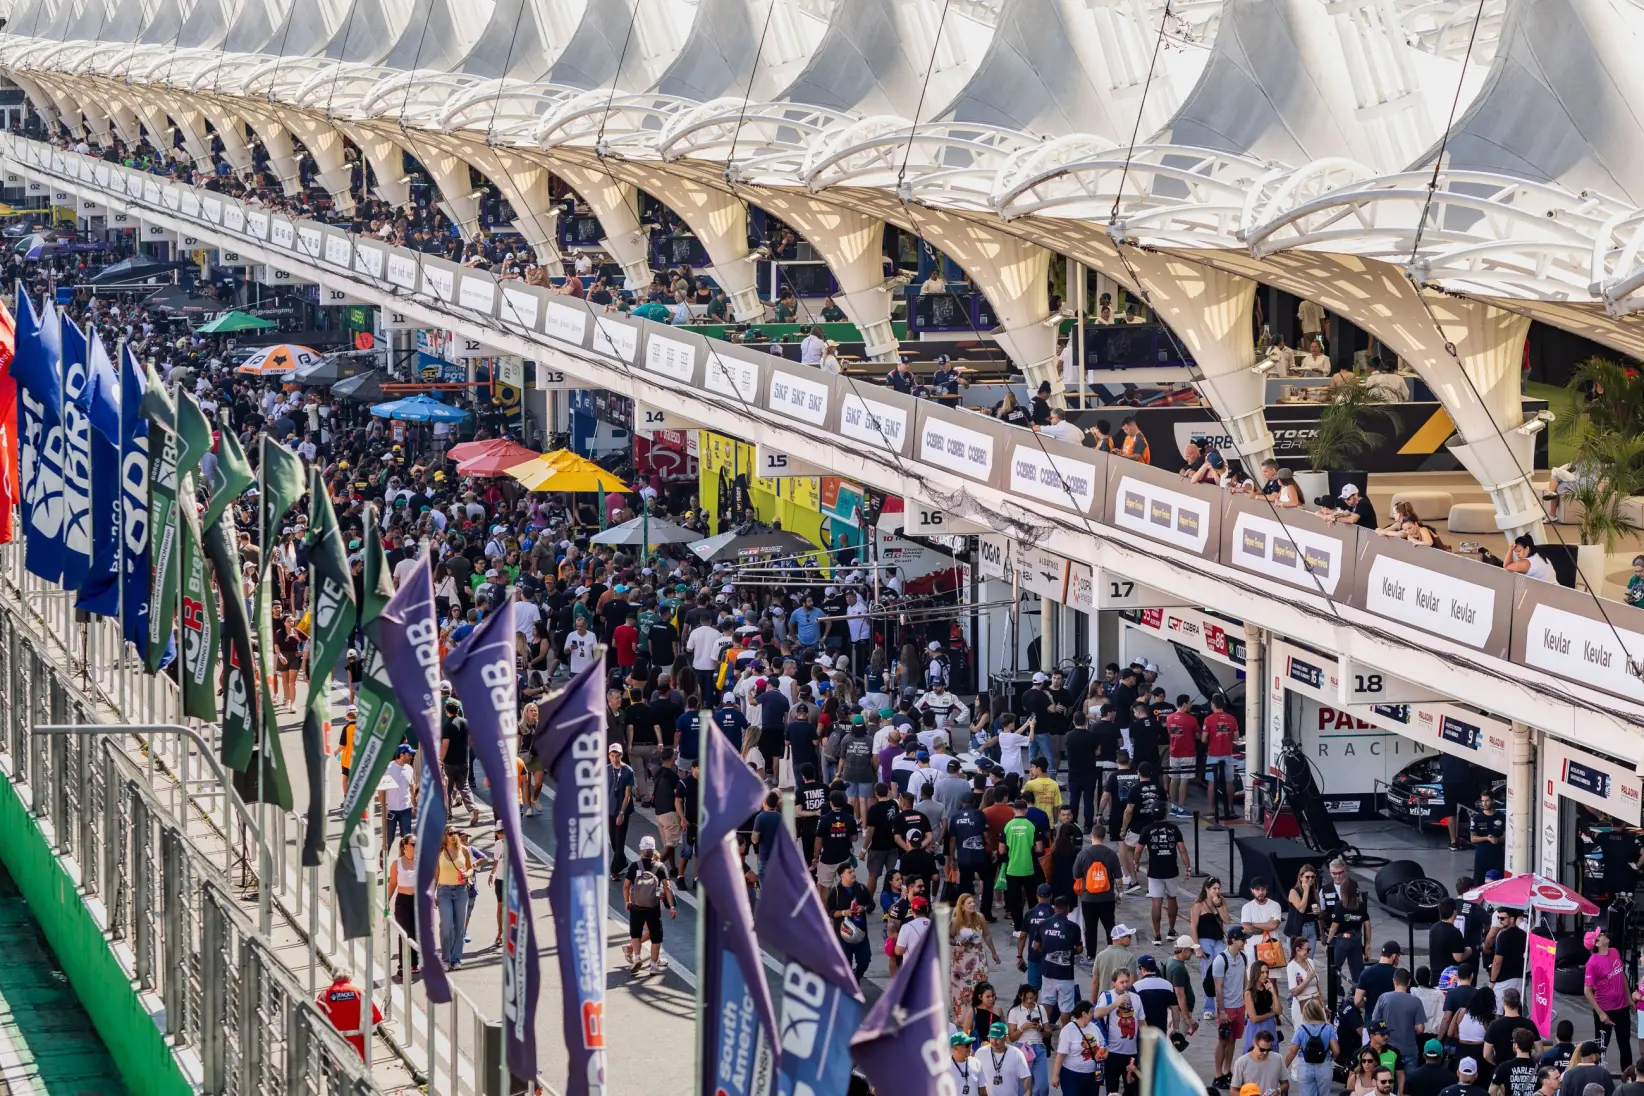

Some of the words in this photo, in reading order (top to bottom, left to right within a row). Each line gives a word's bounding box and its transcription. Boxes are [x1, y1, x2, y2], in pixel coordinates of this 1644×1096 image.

[330, 291, 344, 299] 10
[393, 314, 405, 322] 11
[465, 341, 479, 350] 12
[547, 372, 563, 382] 13
[774, 383, 788, 400] SKF
[792, 390, 806, 407] SKF
[809, 396, 823, 412] SKF
[646, 411, 664, 422] 14
[846, 406, 862, 426] SKF
[884, 418, 901, 438] SKF
[1273, 429, 1320, 438] TOCK
[1206, 436, 1233, 449] BRB
[768, 455, 786, 467] 15
[921, 511, 942, 525] 16
[1111, 582, 1134, 598] 17
[1382, 577, 1406, 603] Kevlar
[1416, 588, 1440, 614] Kevlar
[1451, 598, 1476, 625] Kevlar
[1183, 620, 1200, 635] COBRA
[1216, 633, 1225, 649] 86
[1543, 628, 1571, 655] Kevlar
[1584, 640, 1612, 668] Kevlar
[197, 646, 208, 680] TOURING
[1354, 674, 1382, 692] 18
[481, 659, 518, 734] BRB
[1468, 730, 1473, 743] 9
[572, 731, 602, 814] BRB
[1597, 776, 1602, 791] 3
[804, 789, 825, 799] TIME
[1622, 785, 1638, 799] PALADINI
[805, 799, 825, 810] 1506
[568, 817, 577, 860] banco
[720, 1000, 738, 1082] South
[1510, 1075, 1538, 1083] DAVIDSN
[1511, 1083, 1536, 1091] FACTRY
